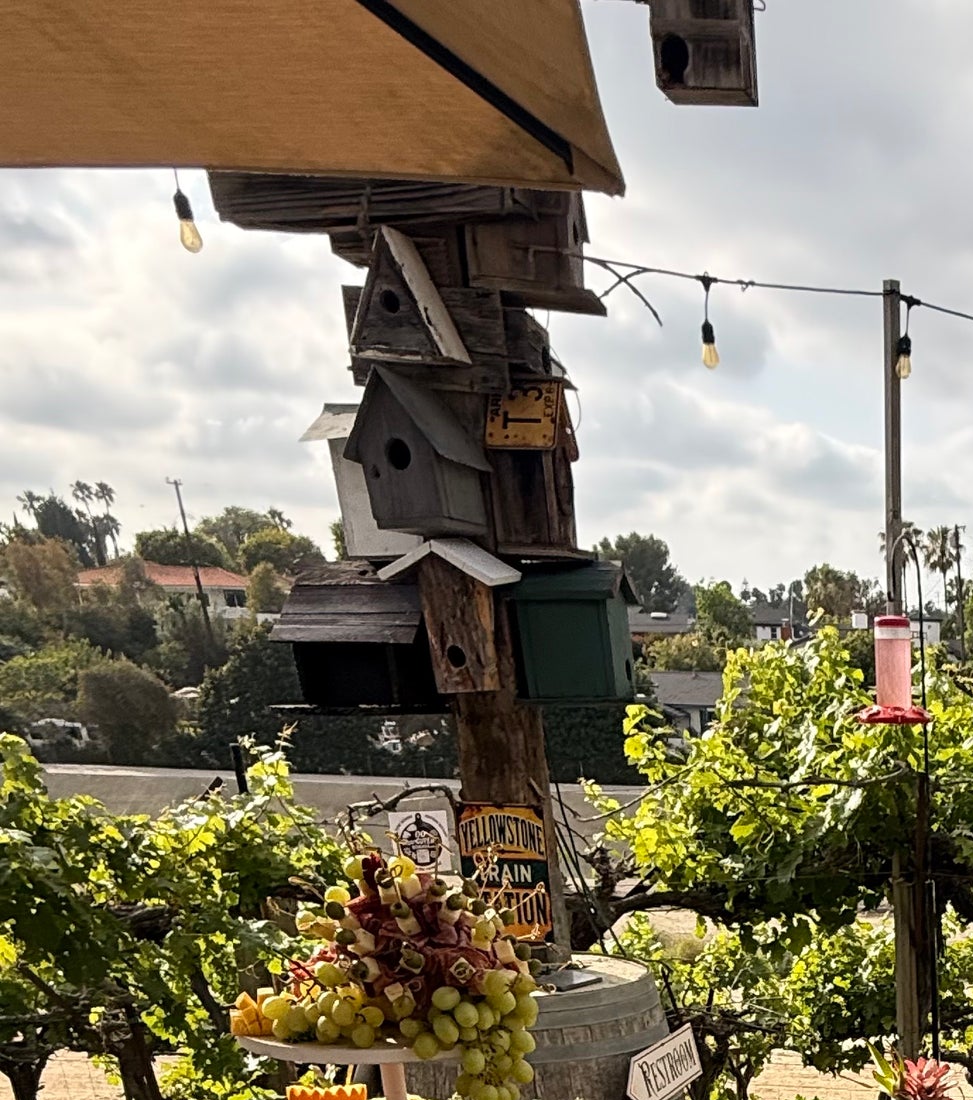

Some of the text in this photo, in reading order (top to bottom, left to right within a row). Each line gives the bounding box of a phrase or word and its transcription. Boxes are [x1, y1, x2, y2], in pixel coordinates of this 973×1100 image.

[460, 813, 545, 856] YELLOWSTONE
[481, 890, 549, 926] TATION
[637, 1038, 697, 1098] RESTROOM
